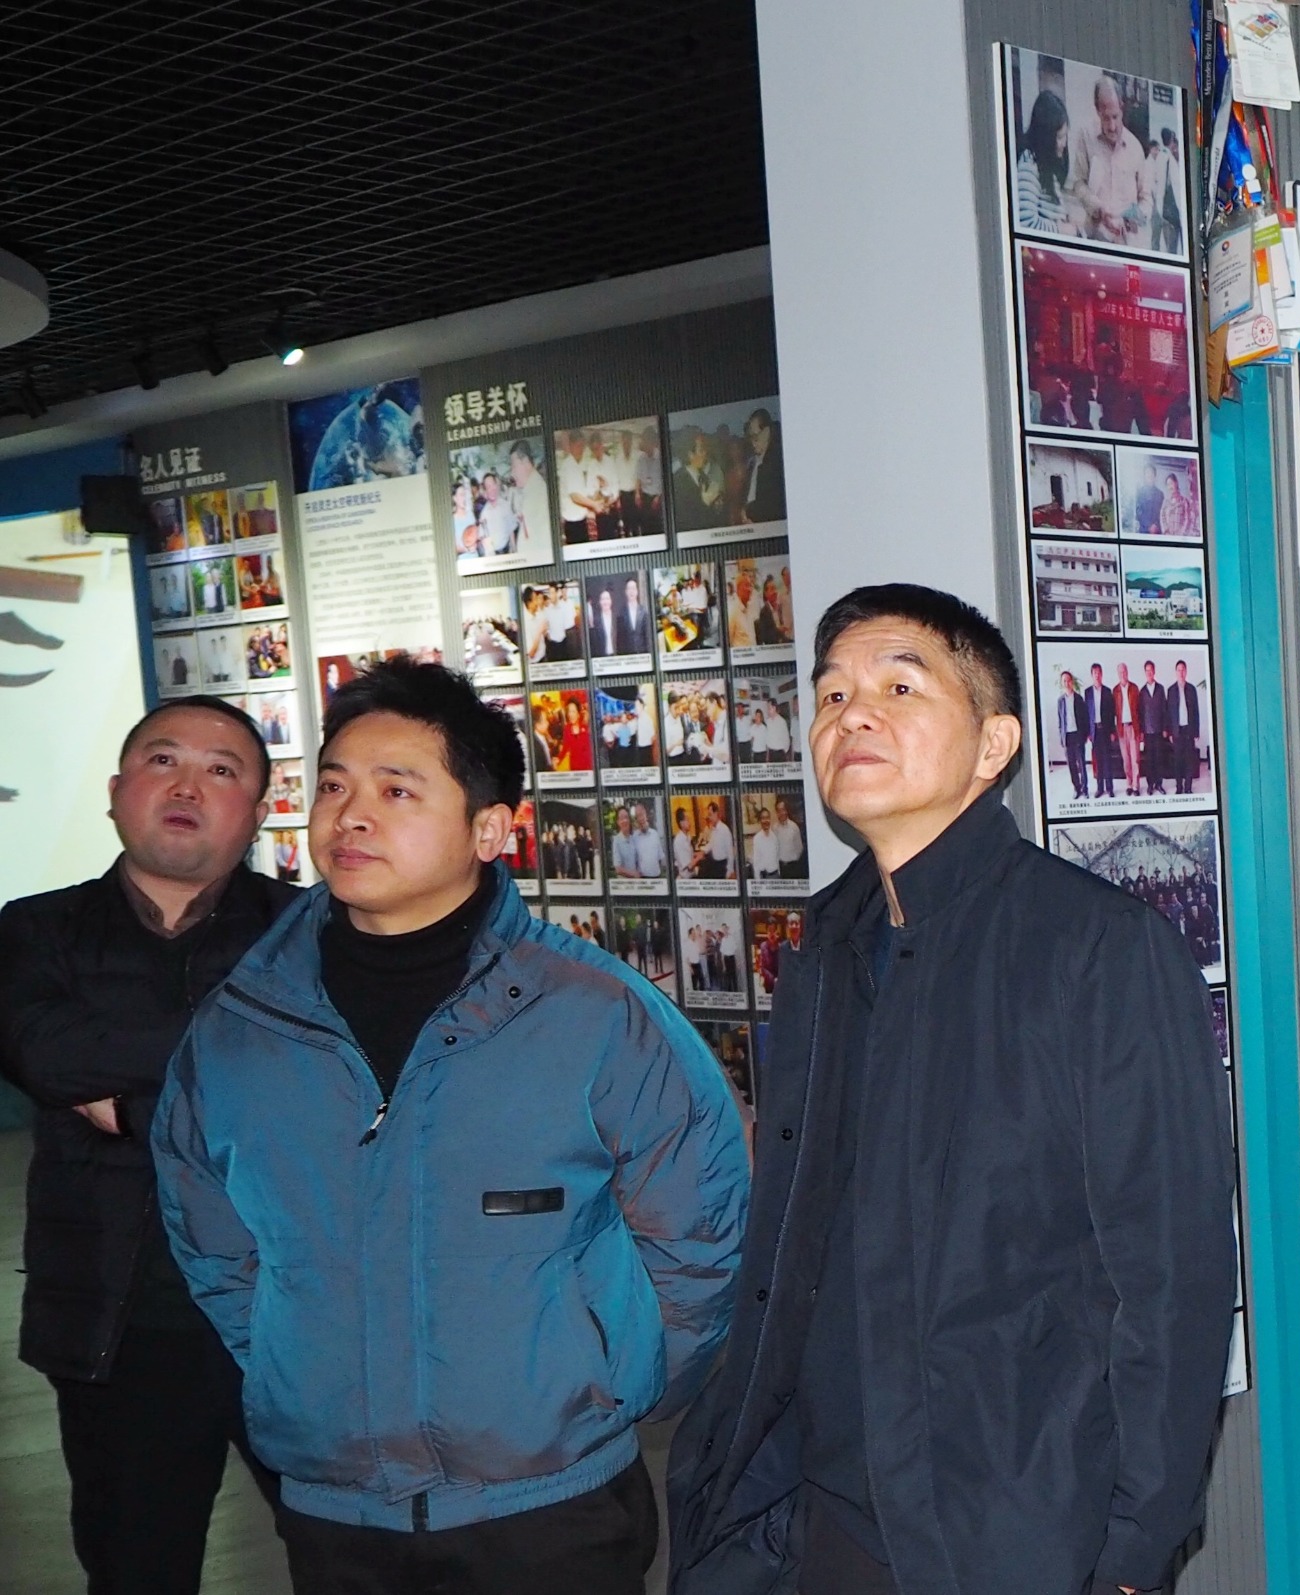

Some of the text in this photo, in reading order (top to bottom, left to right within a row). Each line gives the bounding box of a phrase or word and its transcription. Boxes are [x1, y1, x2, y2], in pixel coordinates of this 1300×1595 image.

[444, 381, 528, 425] 领导关怀
[446, 414, 543, 442] LEADERSHIP CARE
[140, 446, 202, 482] 名人见证
